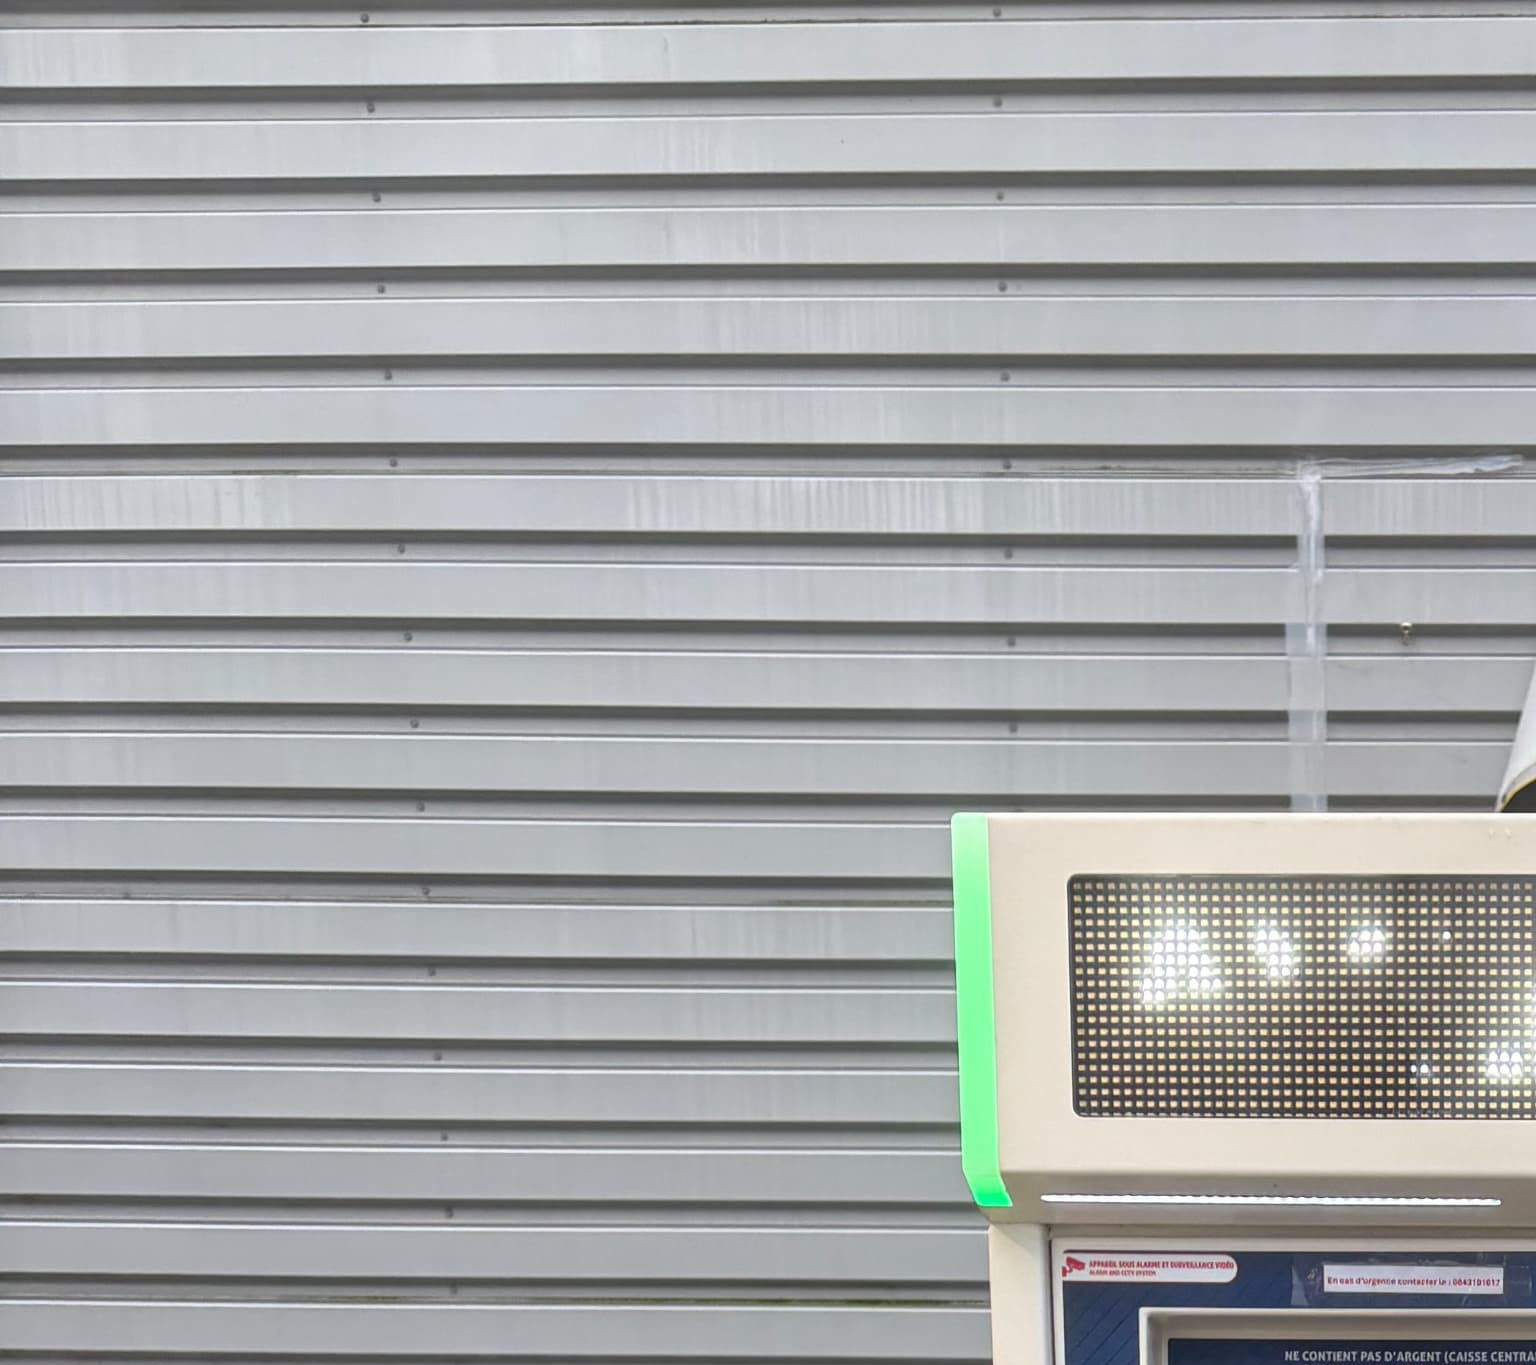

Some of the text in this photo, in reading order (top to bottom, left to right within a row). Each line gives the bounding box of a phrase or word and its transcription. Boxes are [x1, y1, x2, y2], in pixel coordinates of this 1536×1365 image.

[1285, 1351, 1300, 1362] NE
[1302, 1351, 1358, 1362] CONTIENT
[1360, 1351, 1382, 1362] PAS
[1384, 1351, 1441, 1362] D'ARGENT
[1444, 1351, 1488, 1364] (CAISSE
